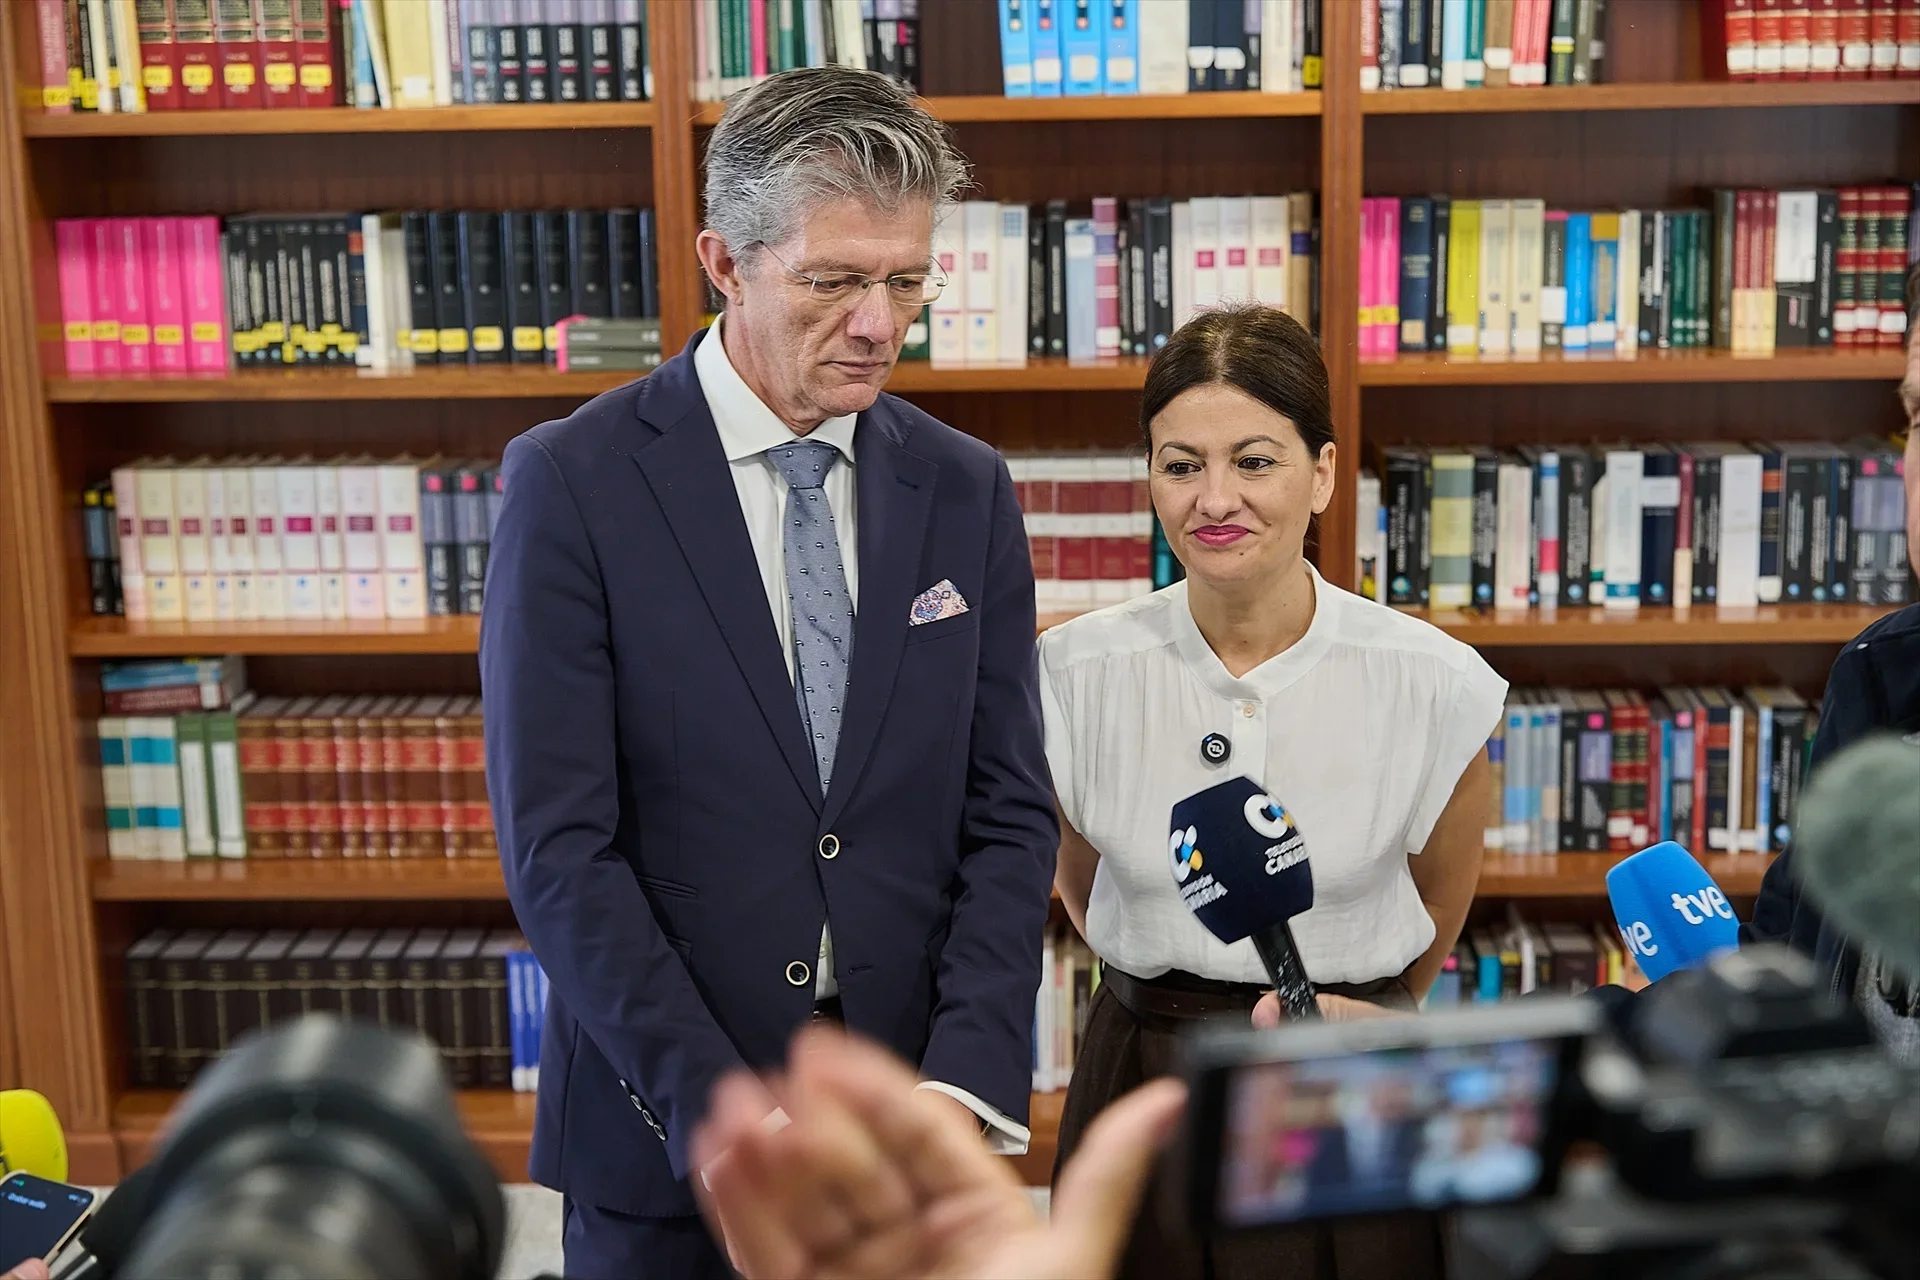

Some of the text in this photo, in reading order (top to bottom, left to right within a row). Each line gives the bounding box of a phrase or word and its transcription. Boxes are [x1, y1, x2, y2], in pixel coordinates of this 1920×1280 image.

[1265, 845, 1309, 876] CANAR
[1185, 881, 1228, 913] NARIA
[1670, 886, 1733, 926] tve
[1618, 921, 1659, 957] ve
